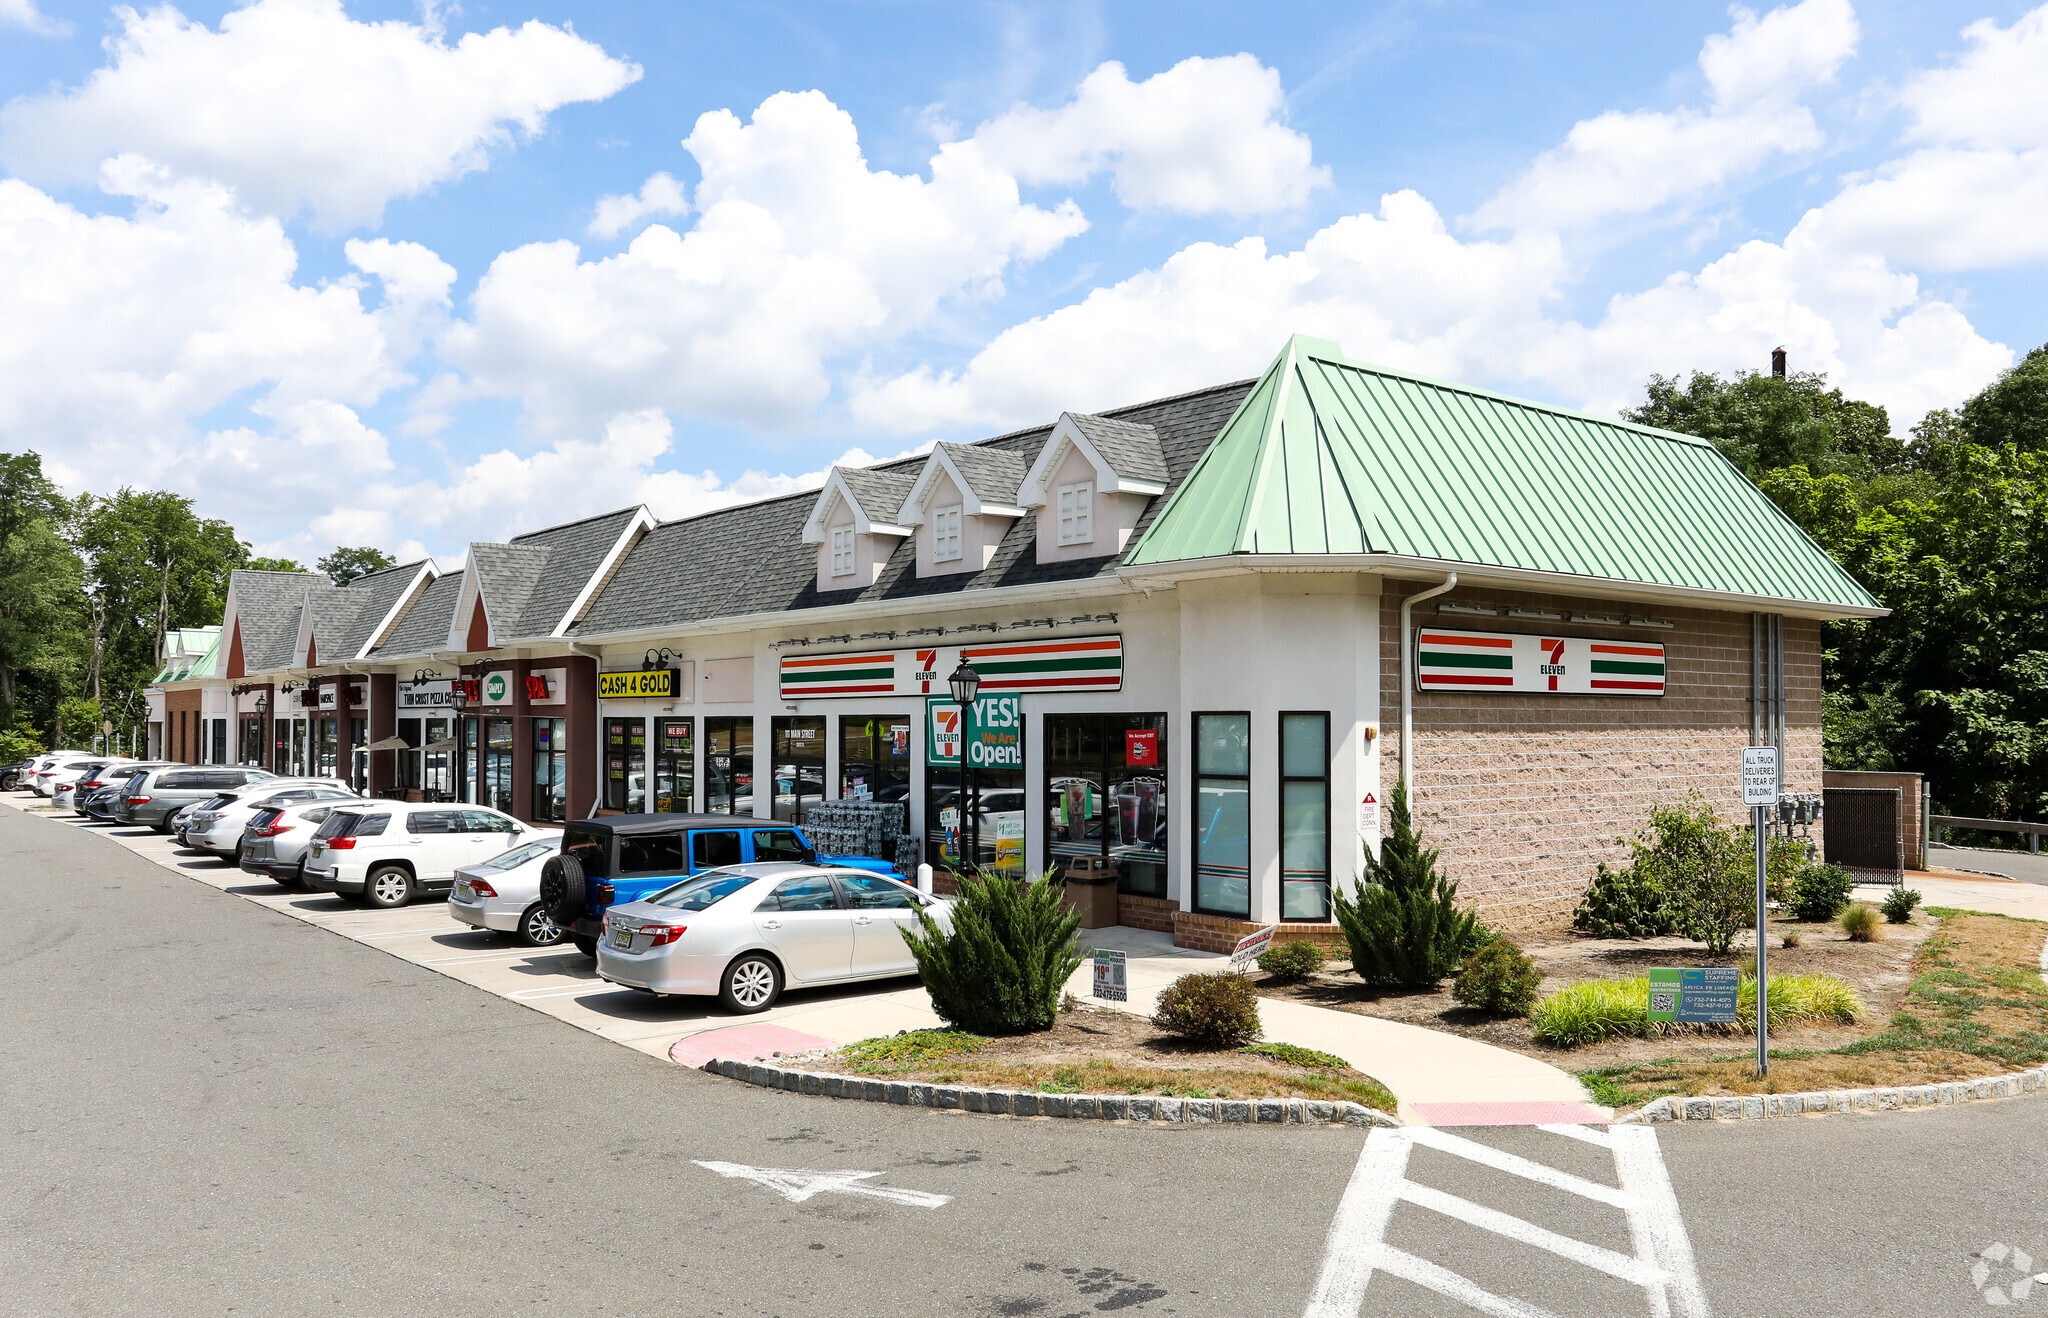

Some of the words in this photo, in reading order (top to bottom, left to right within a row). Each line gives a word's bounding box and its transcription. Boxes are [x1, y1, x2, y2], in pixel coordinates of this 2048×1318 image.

[488, 682, 504, 694] SIMPLY
[526, 675, 546, 700] SPA
[600, 676, 627, 694] CASH
[630, 676, 637, 693] 4
[640, 674, 670, 693] GOLD
[404, 693, 414, 705] THIN
[415, 693, 429, 705] CRUST
[430, 692, 444, 704] PIZZA
[972, 698, 1019, 728] YES!
[668, 727, 676, 735] WE
[676, 727, 686, 735] BUY
[790, 729, 800, 738] MAIN
[801, 729, 815, 738] STREET
[981, 732, 996, 744] We
[998, 733, 1016, 744] Are
[971, 741, 1022, 767] Open!
[1757, 756, 1774, 764] TRUCK
[1745, 767, 1775, 775] DELIVERIES
[1744, 777, 1752, 785] TO
[1753, 777, 1767, 785] REAR
[1768, 777, 1775, 785] OF
[1749, 788, 1772, 796] BUILDING
